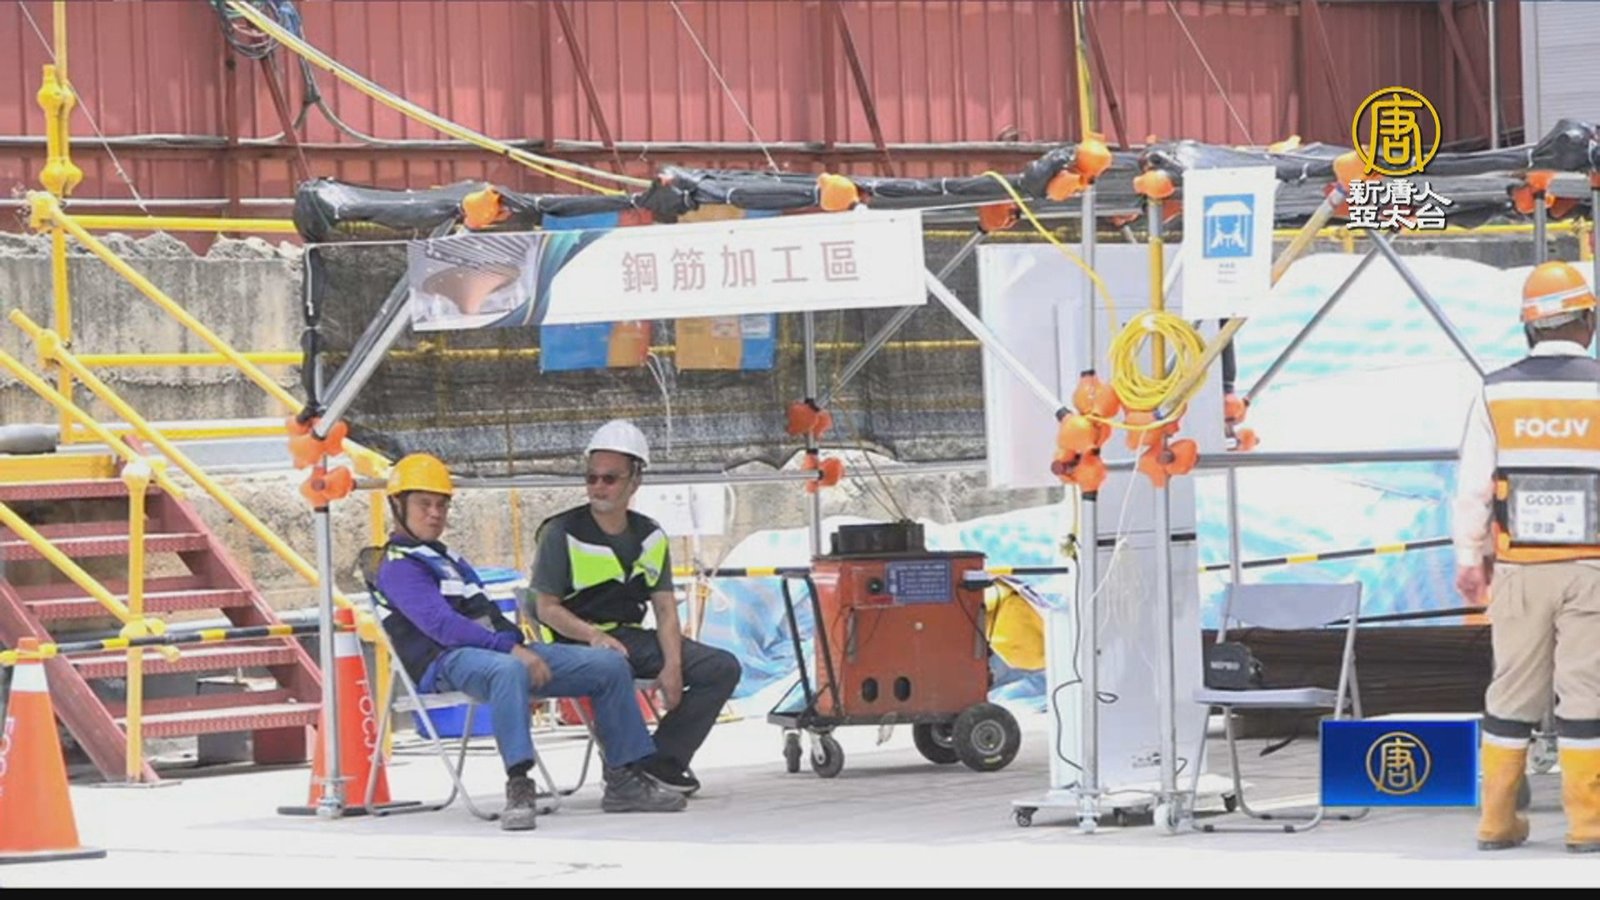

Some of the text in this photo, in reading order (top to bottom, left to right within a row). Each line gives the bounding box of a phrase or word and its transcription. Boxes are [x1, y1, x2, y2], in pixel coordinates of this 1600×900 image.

[621, 240, 860, 293] 鋼筋加工區
[1514, 418, 1589, 438] FOCJV
